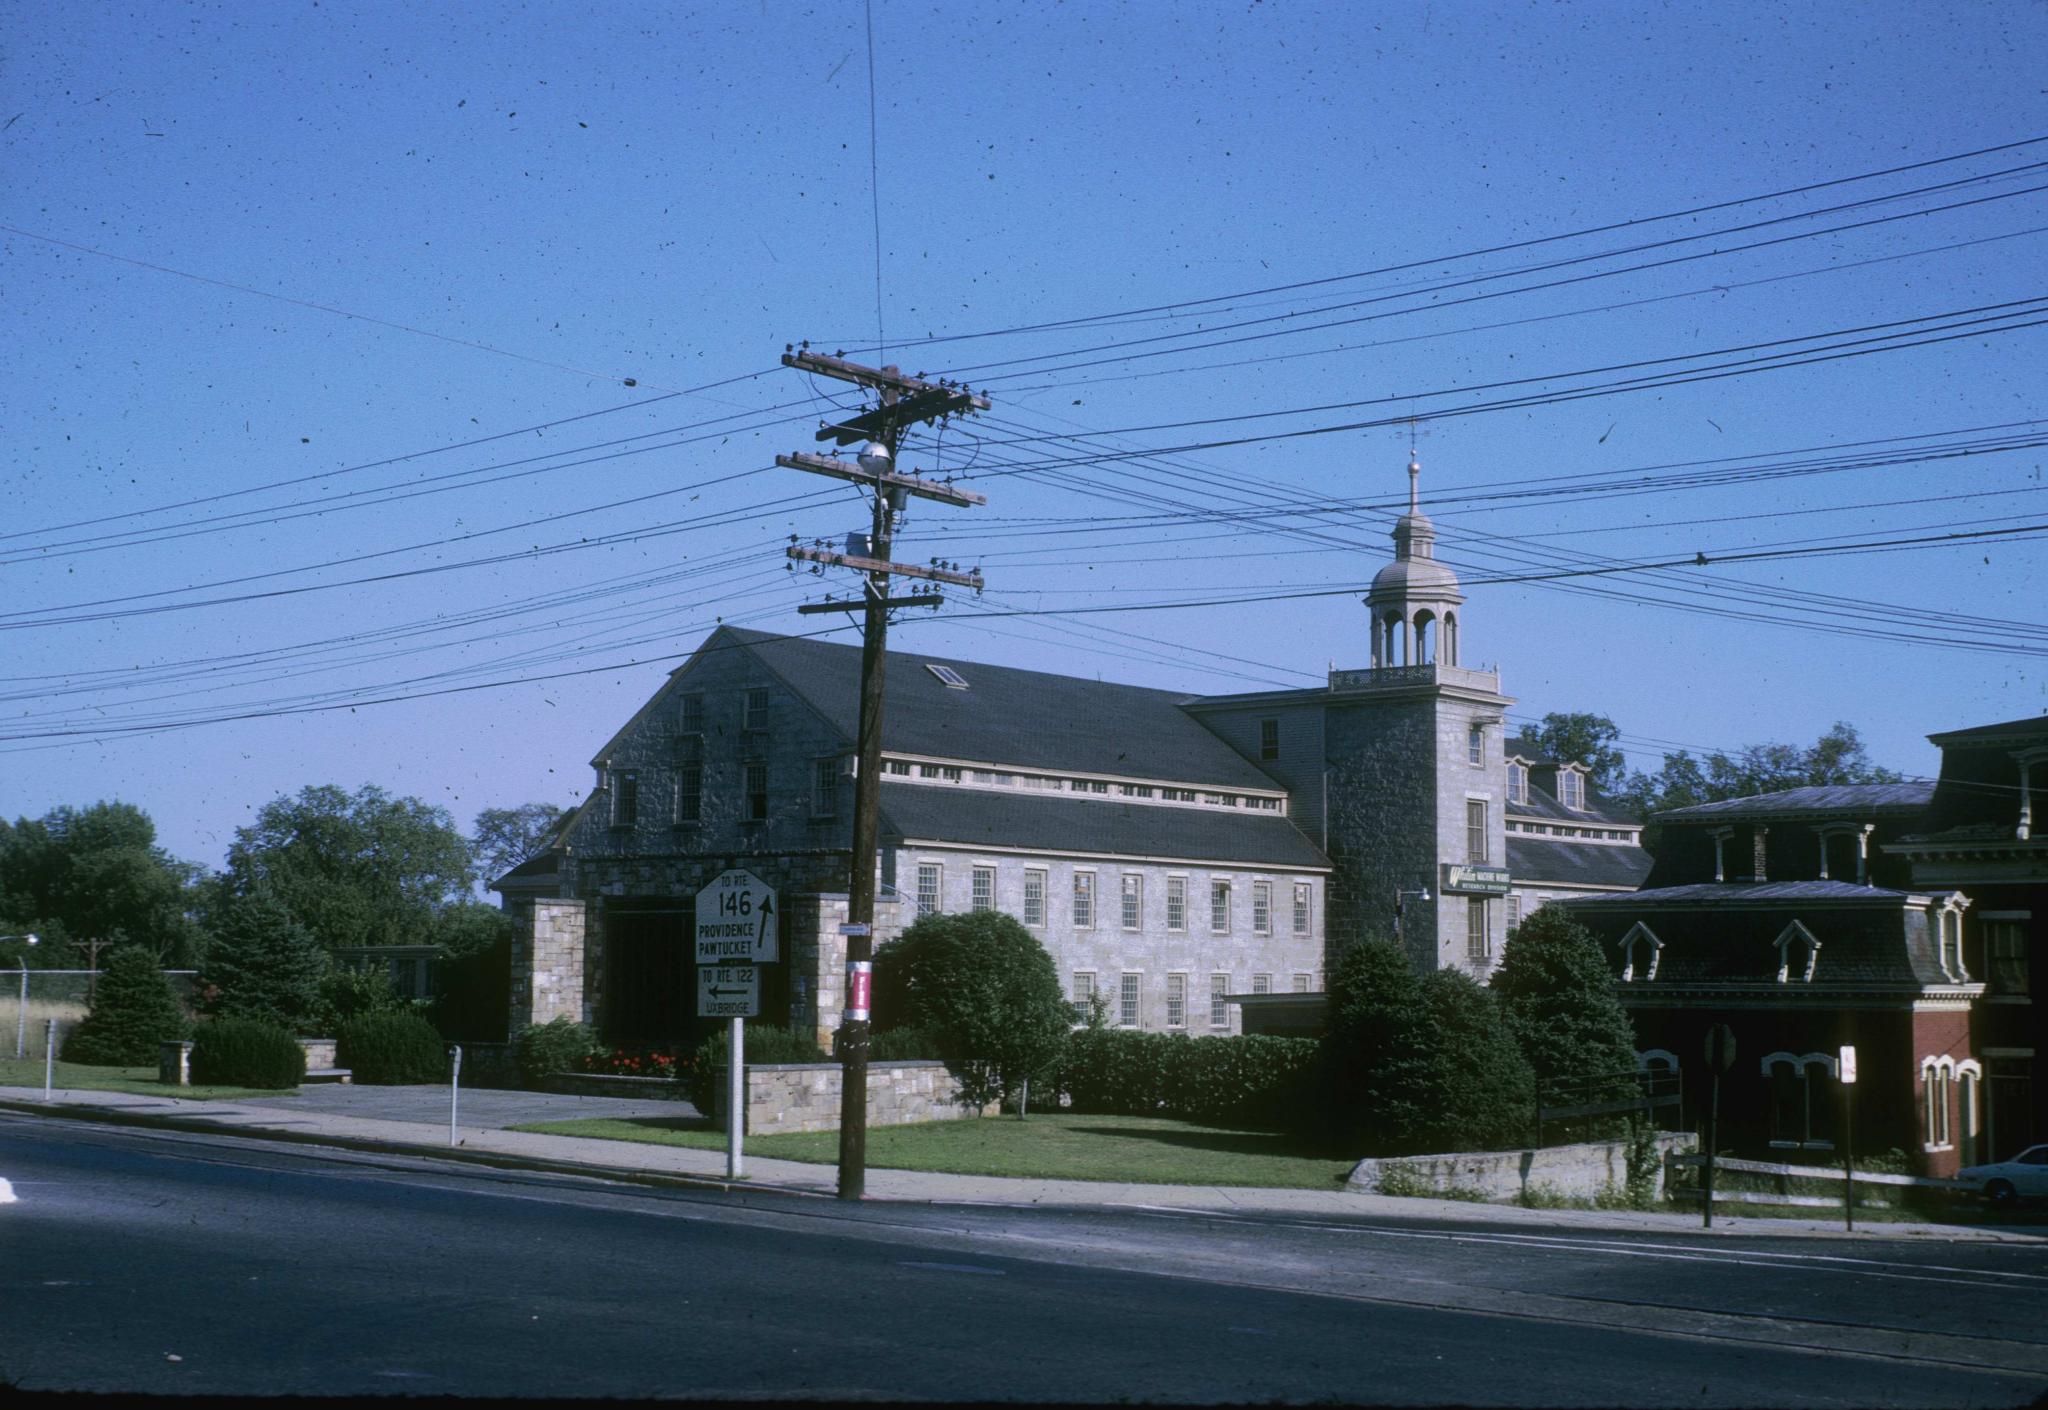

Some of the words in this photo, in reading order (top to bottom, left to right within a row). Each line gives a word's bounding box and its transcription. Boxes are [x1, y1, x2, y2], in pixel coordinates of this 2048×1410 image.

[721, 875, 731, 887] TO
[734, 874, 748, 886] RTE
[719, 890, 752, 917] 146
[699, 923, 754, 937] PROVIDENCE
[699, 941, 753, 955] PAWTUCKET
[703, 969, 712, 983] TO
[737, 969, 753, 982] 122
[706, 1002, 750, 1014] UXBRIDGE
